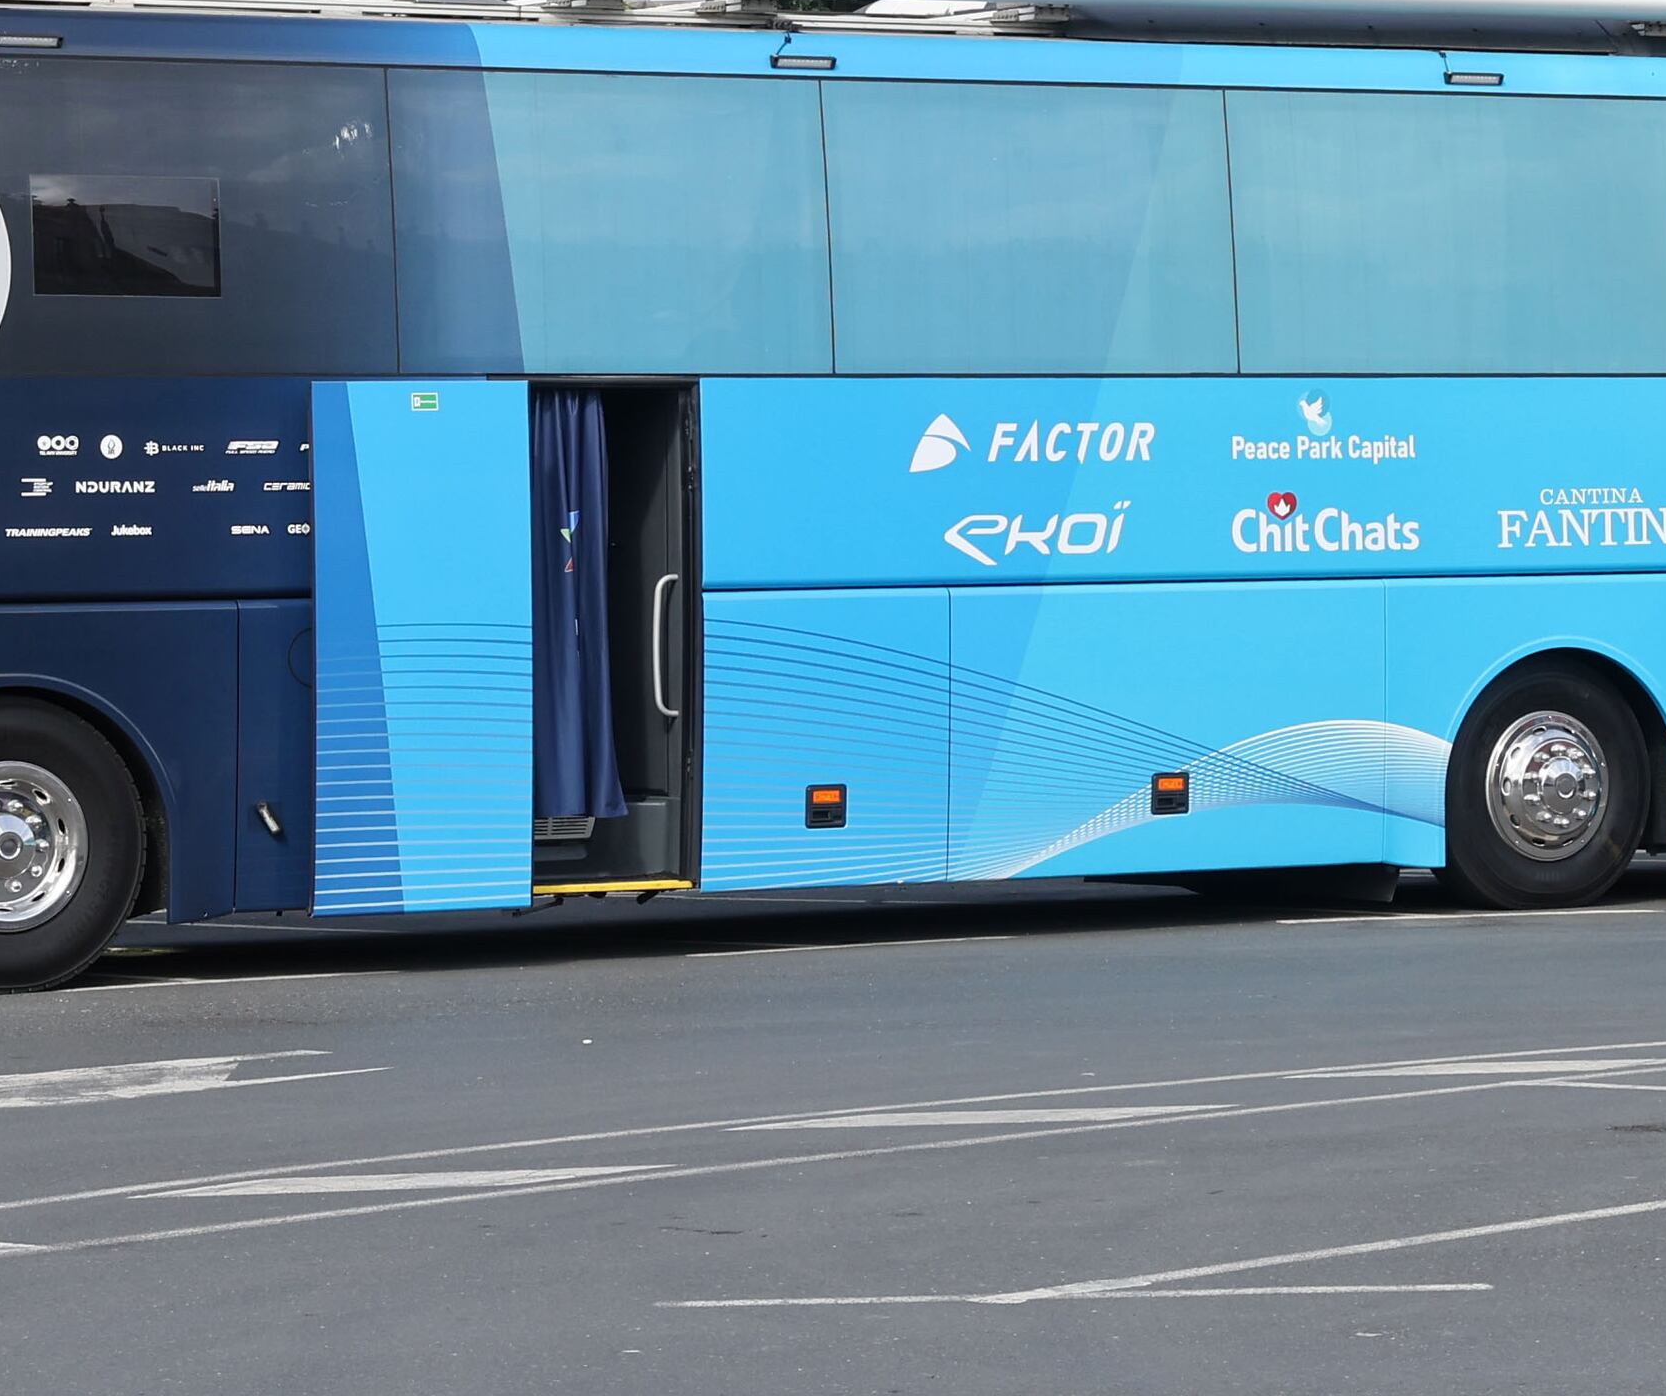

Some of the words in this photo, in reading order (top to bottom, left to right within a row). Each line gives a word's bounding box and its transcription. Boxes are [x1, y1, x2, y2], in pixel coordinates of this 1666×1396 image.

[161, 444, 188, 452] BLACK
[190, 444, 205, 452] INC
[987, 420, 1155, 465] FACTOR
[1231, 435, 1291, 460] Peace
[1296, 435, 1343, 460] Park
[1348, 434, 1417, 465] Capital
[75, 480, 156, 494] NDURANZ
[1539, 488, 1644, 505] CANTINA
[5, 527, 93, 537] TRAININGPEAKS
[110, 524, 153, 536] Jukebox
[230, 525, 270, 535] SENA
